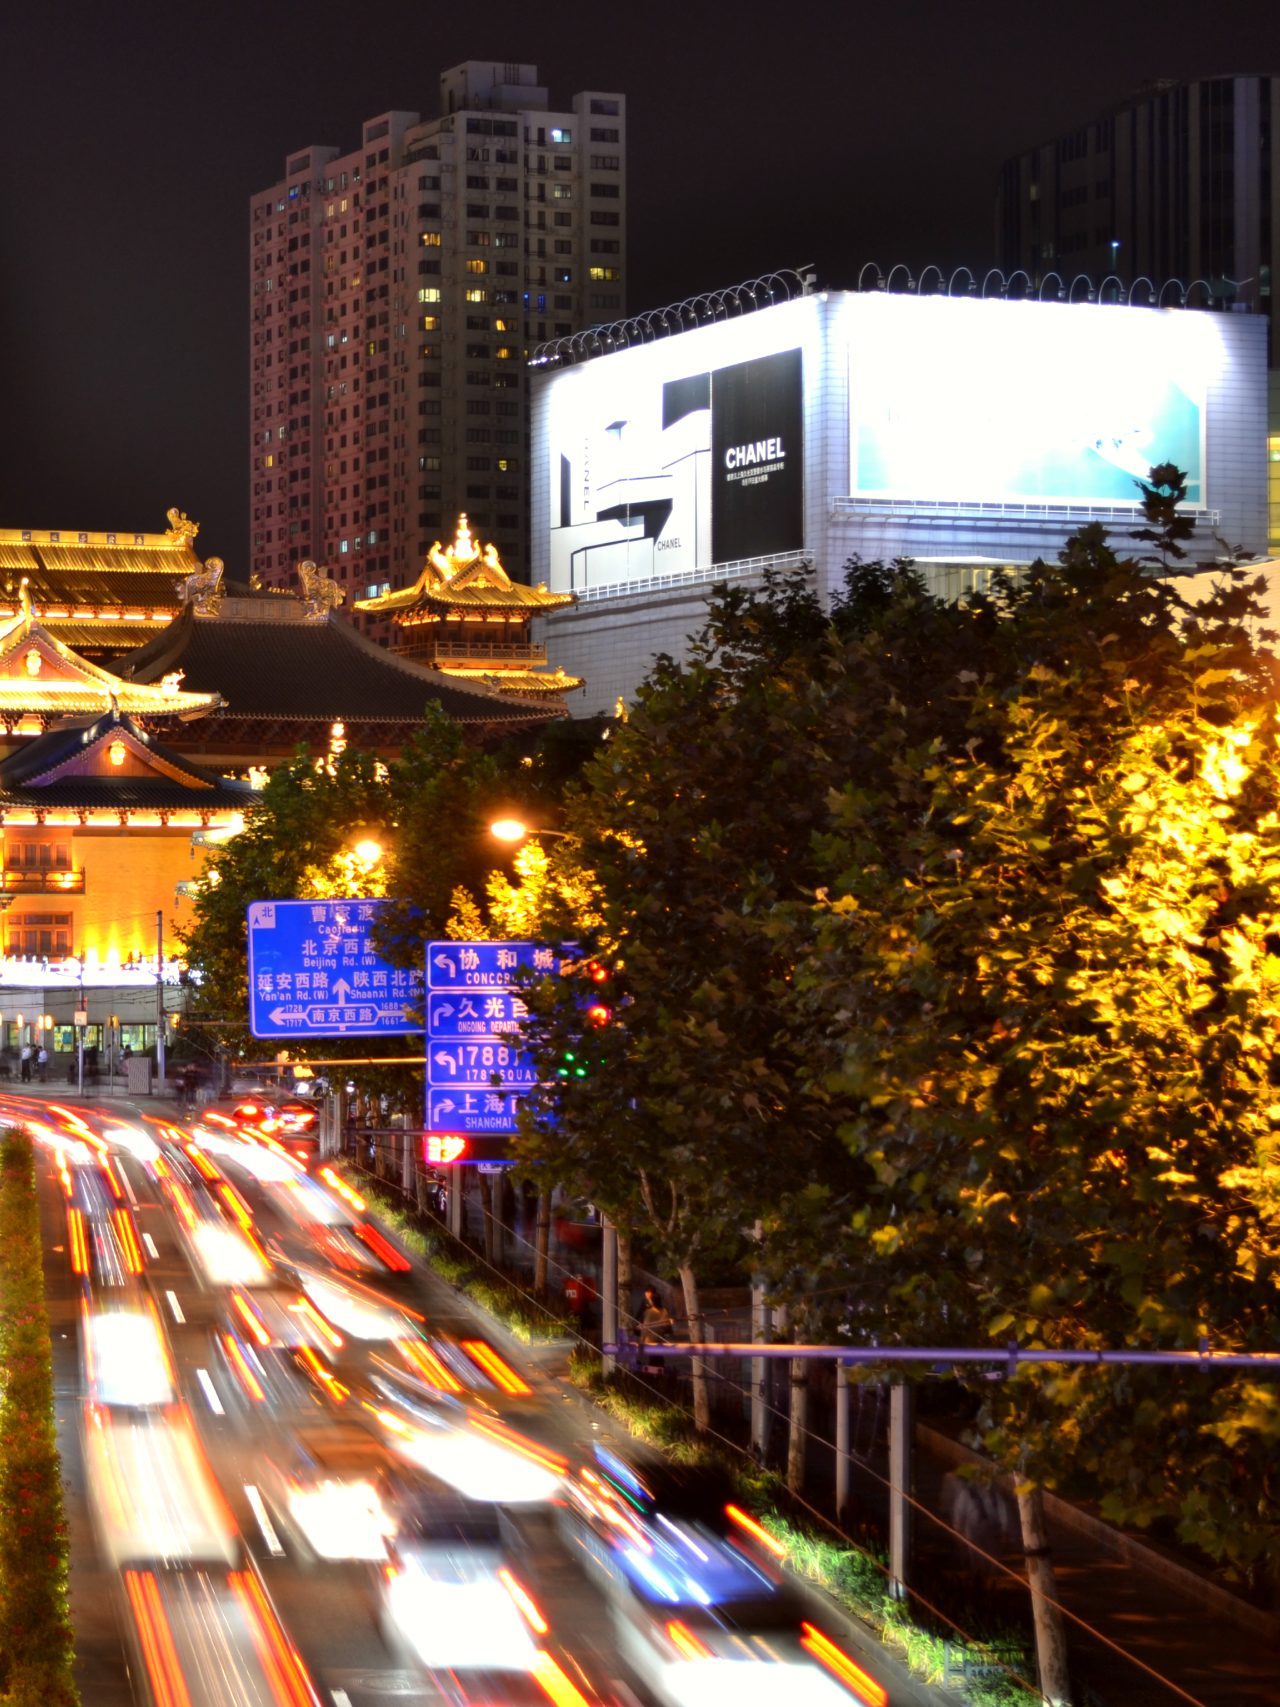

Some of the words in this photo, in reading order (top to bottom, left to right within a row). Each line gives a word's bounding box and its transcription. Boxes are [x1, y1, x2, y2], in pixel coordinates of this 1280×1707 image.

[725, 436, 786, 469] CHANEL
[657, 537, 682, 551] CHANEL
[262, 907, 273, 918] 北
[311, 905, 375, 923] 曹家渡
[301, 938, 378, 956] 北京西路
[304, 957, 336, 969] Beijing
[459, 948, 554, 970] 协和城
[257, 971, 329, 990] 延安西路
[353, 970, 424, 987] 陕西北路
[259, 990, 292, 1001] Yan'an
[350, 989, 387, 999] Shaanxi
[286, 1004, 303, 1013] 1728
[381, 1002, 399, 1010] 1688
[458, 997, 528, 1018] 久光百
[312, 1008, 372, 1023] 南京西路
[382, 1016, 399, 1025] 1661
[286, 1019, 303, 1028] 1717
[458, 1021, 486, 1033] ONGOING
[465, 1117, 512, 1129] SHANGHAI
